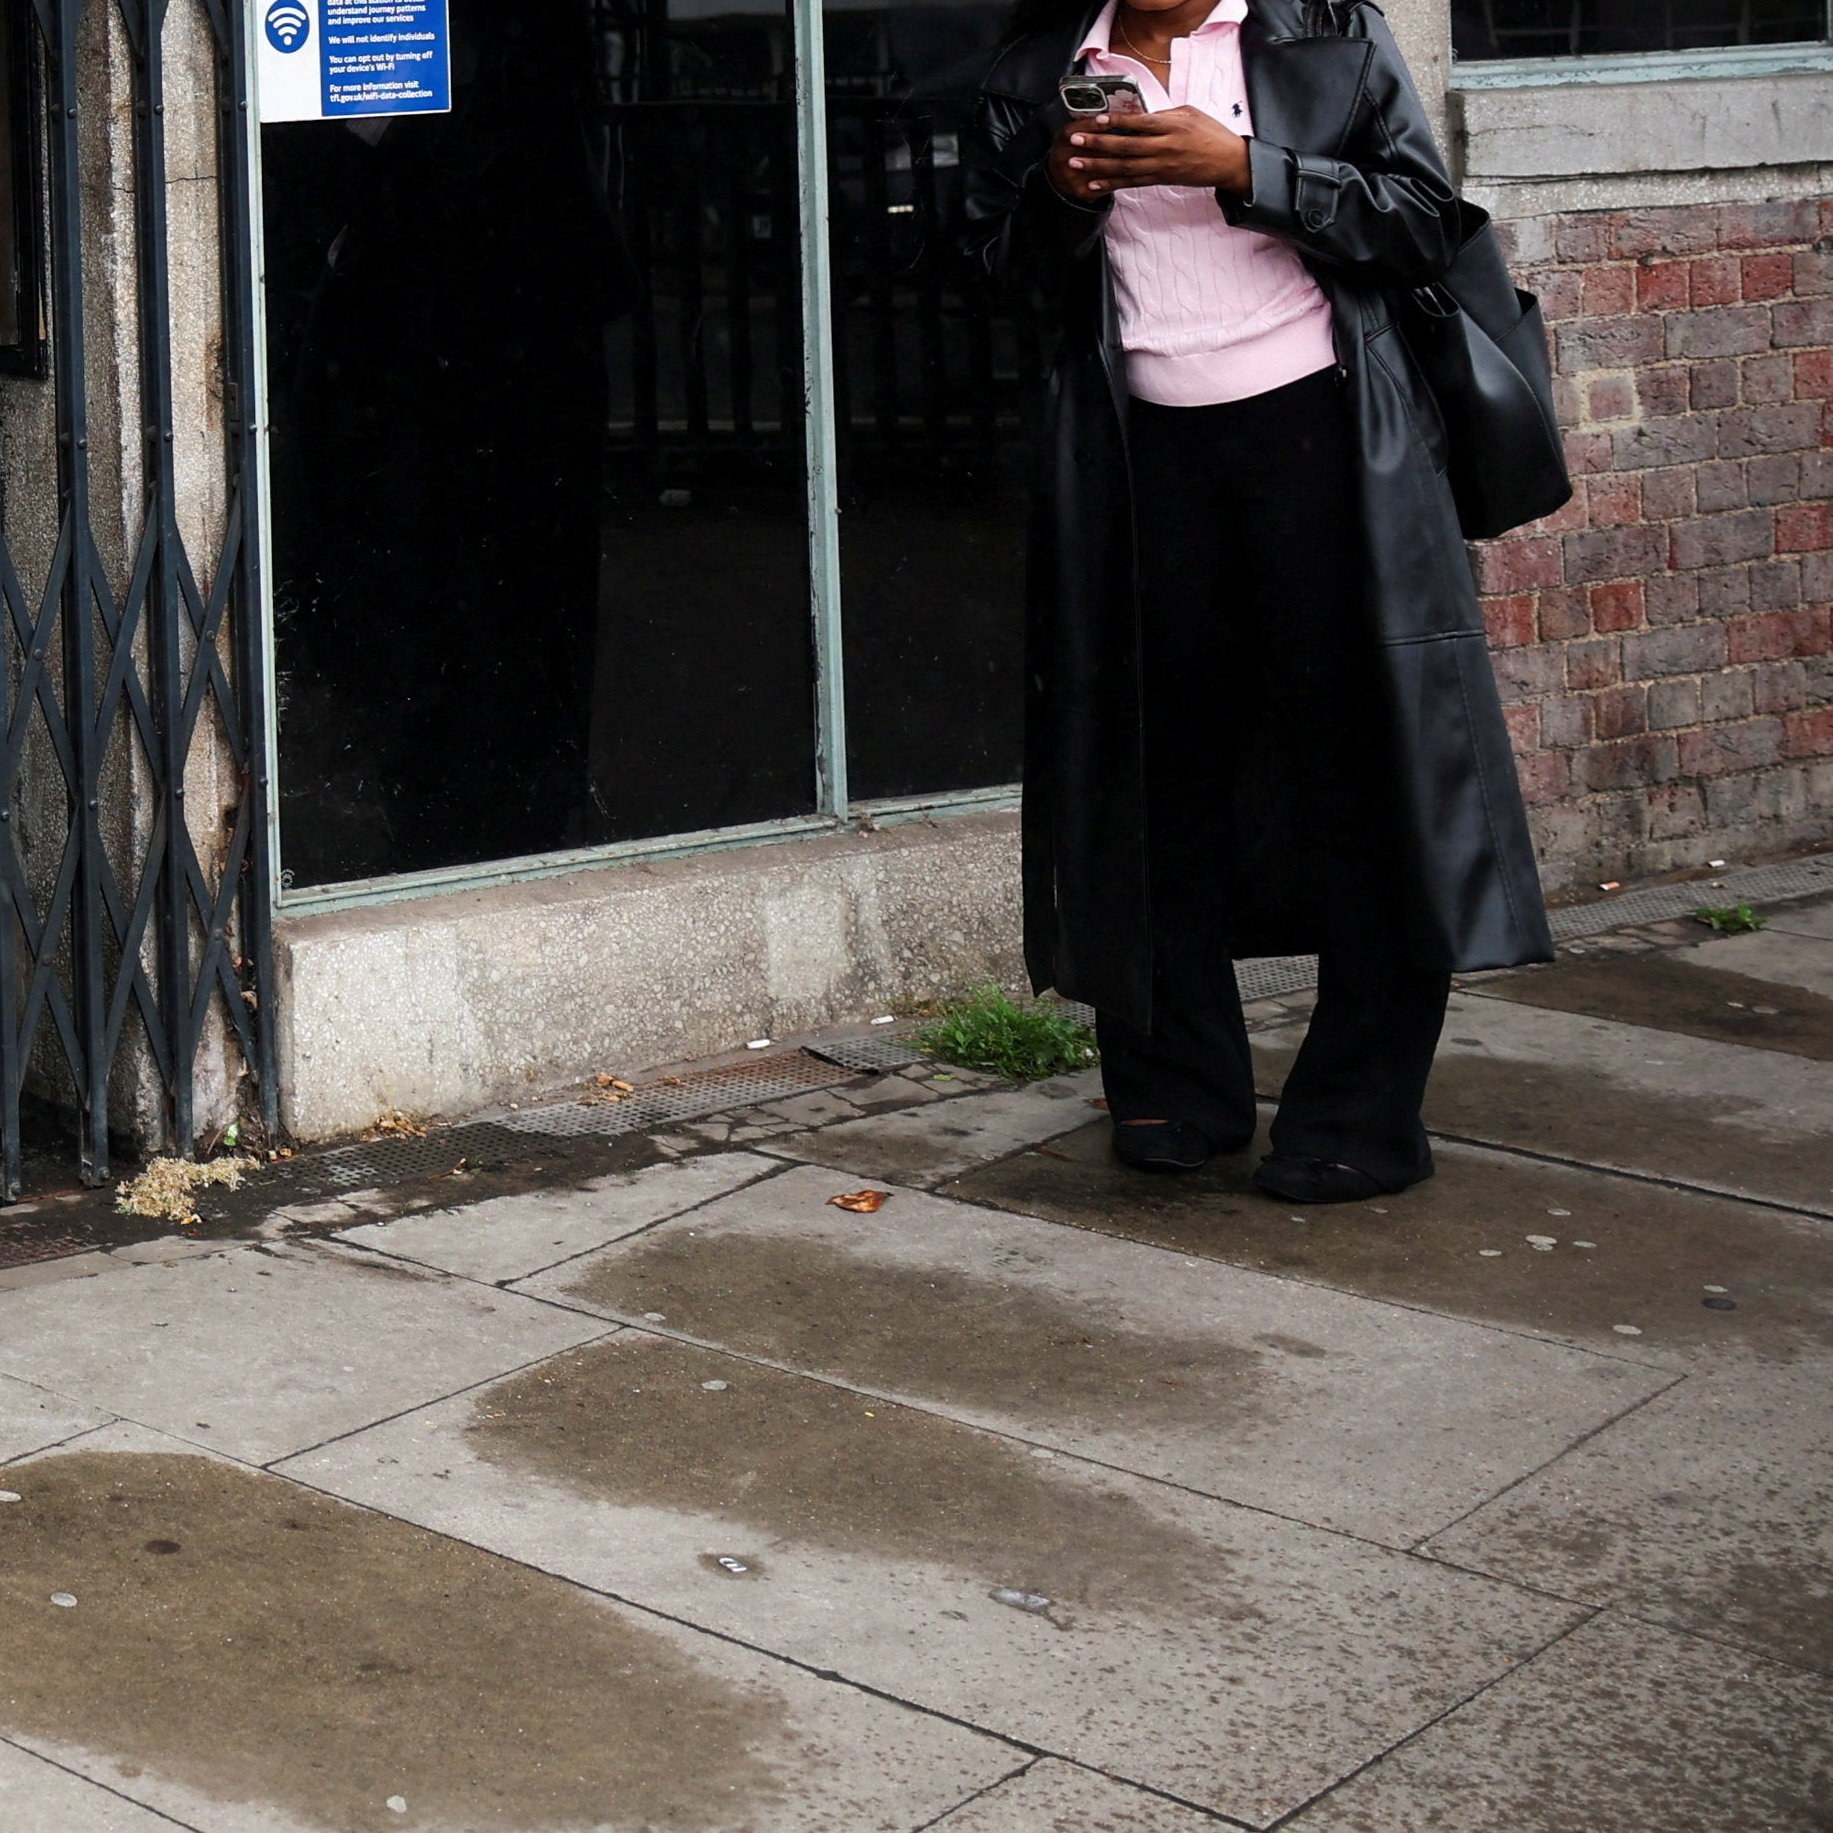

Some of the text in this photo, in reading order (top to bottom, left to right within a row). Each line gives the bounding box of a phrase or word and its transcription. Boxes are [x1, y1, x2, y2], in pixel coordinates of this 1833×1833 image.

[330, 80, 419, 93] For more information visit
